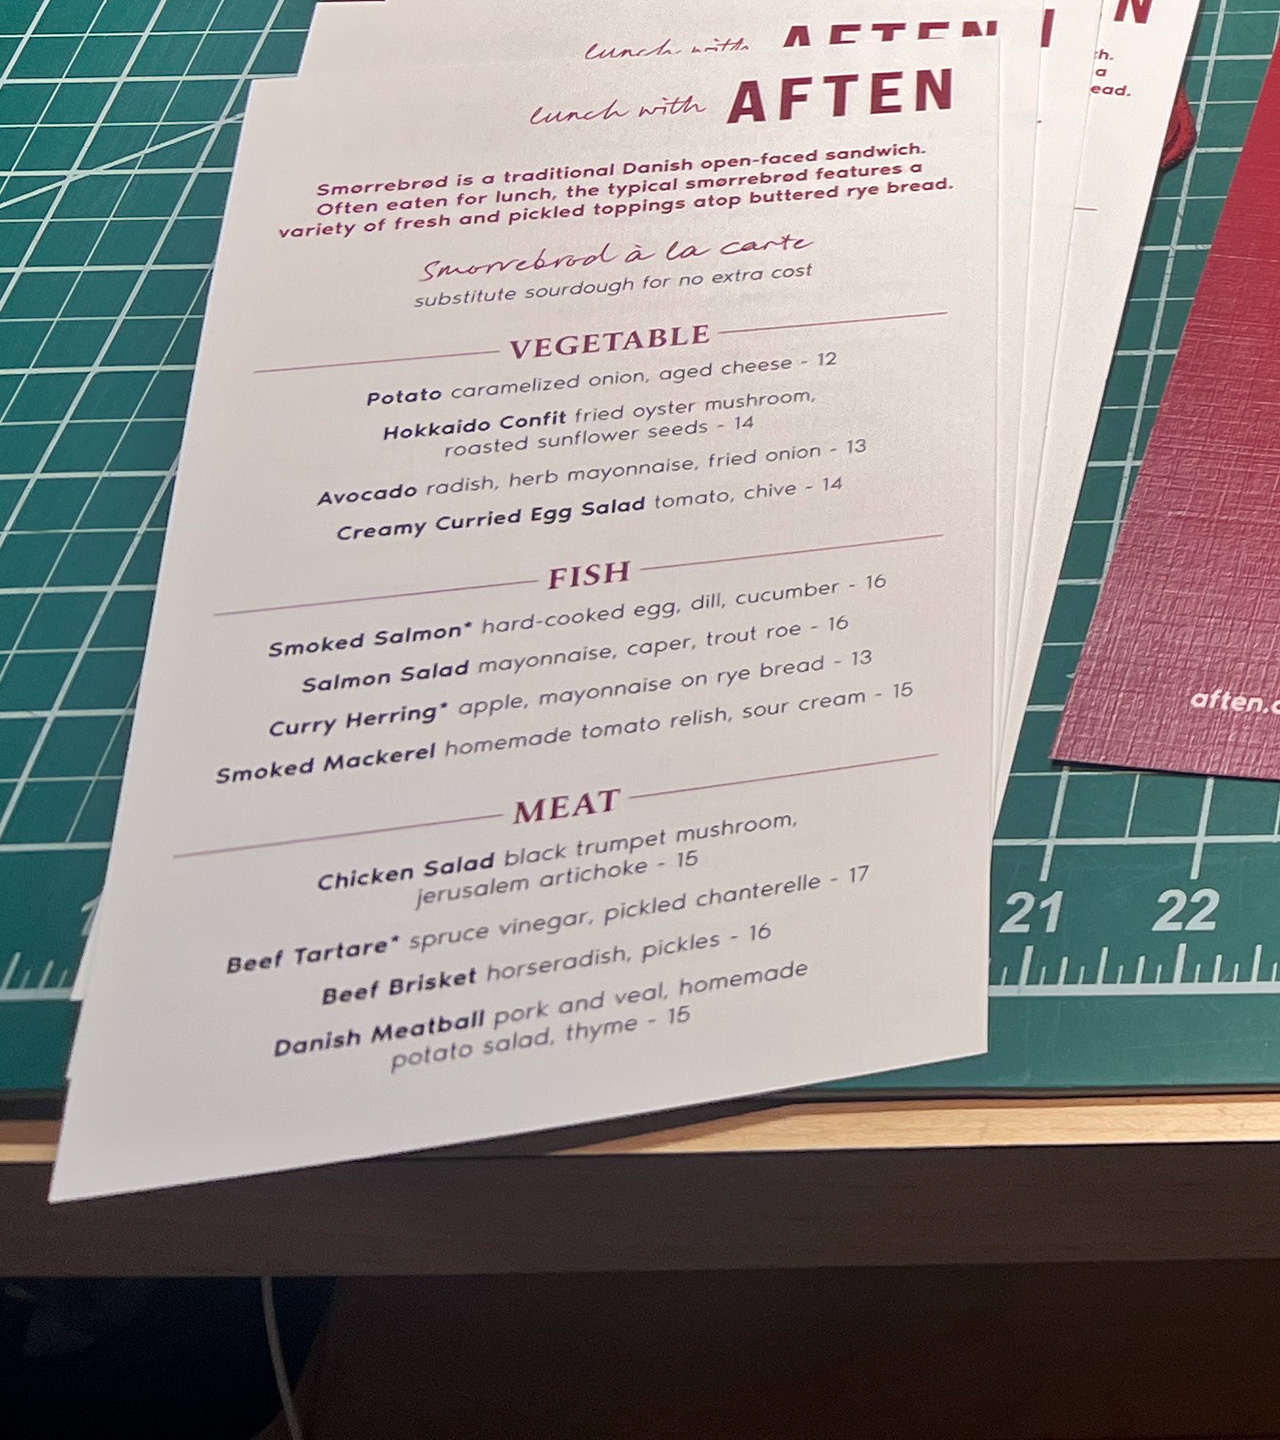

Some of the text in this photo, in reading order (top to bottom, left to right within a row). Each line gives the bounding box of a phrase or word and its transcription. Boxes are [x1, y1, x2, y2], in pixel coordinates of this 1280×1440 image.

[530, 68, 952, 126] lunch with AFTEN
[317, 143, 926, 196] Smørrebrød is a traditional Danish open-faced sandwich.
[317, 164, 922, 216] Often eaten for lunch, the typical smørrebrød features a
[414, 263, 812, 307] substitute sourdough for no extra cost
[510, 325, 709, 359] VEGETABLE
[367, 352, 837, 406] Potato caramelized onion, aged cheese 12
[384, 392, 814, 440] Hokkaido Confit fried oyster mushroom,
[548, 561, 630, 589] FISH
[302, 615, 848, 693] Salmon Salad mayonnaise, caper, trout roe 16
[513, 789, 621, 824] MEAT
[318, 815, 796, 891] Chicken Salad black trumpet mushroom,
[999, 891, 1063, 933] 21
[1151, 889, 1219, 931] 22
